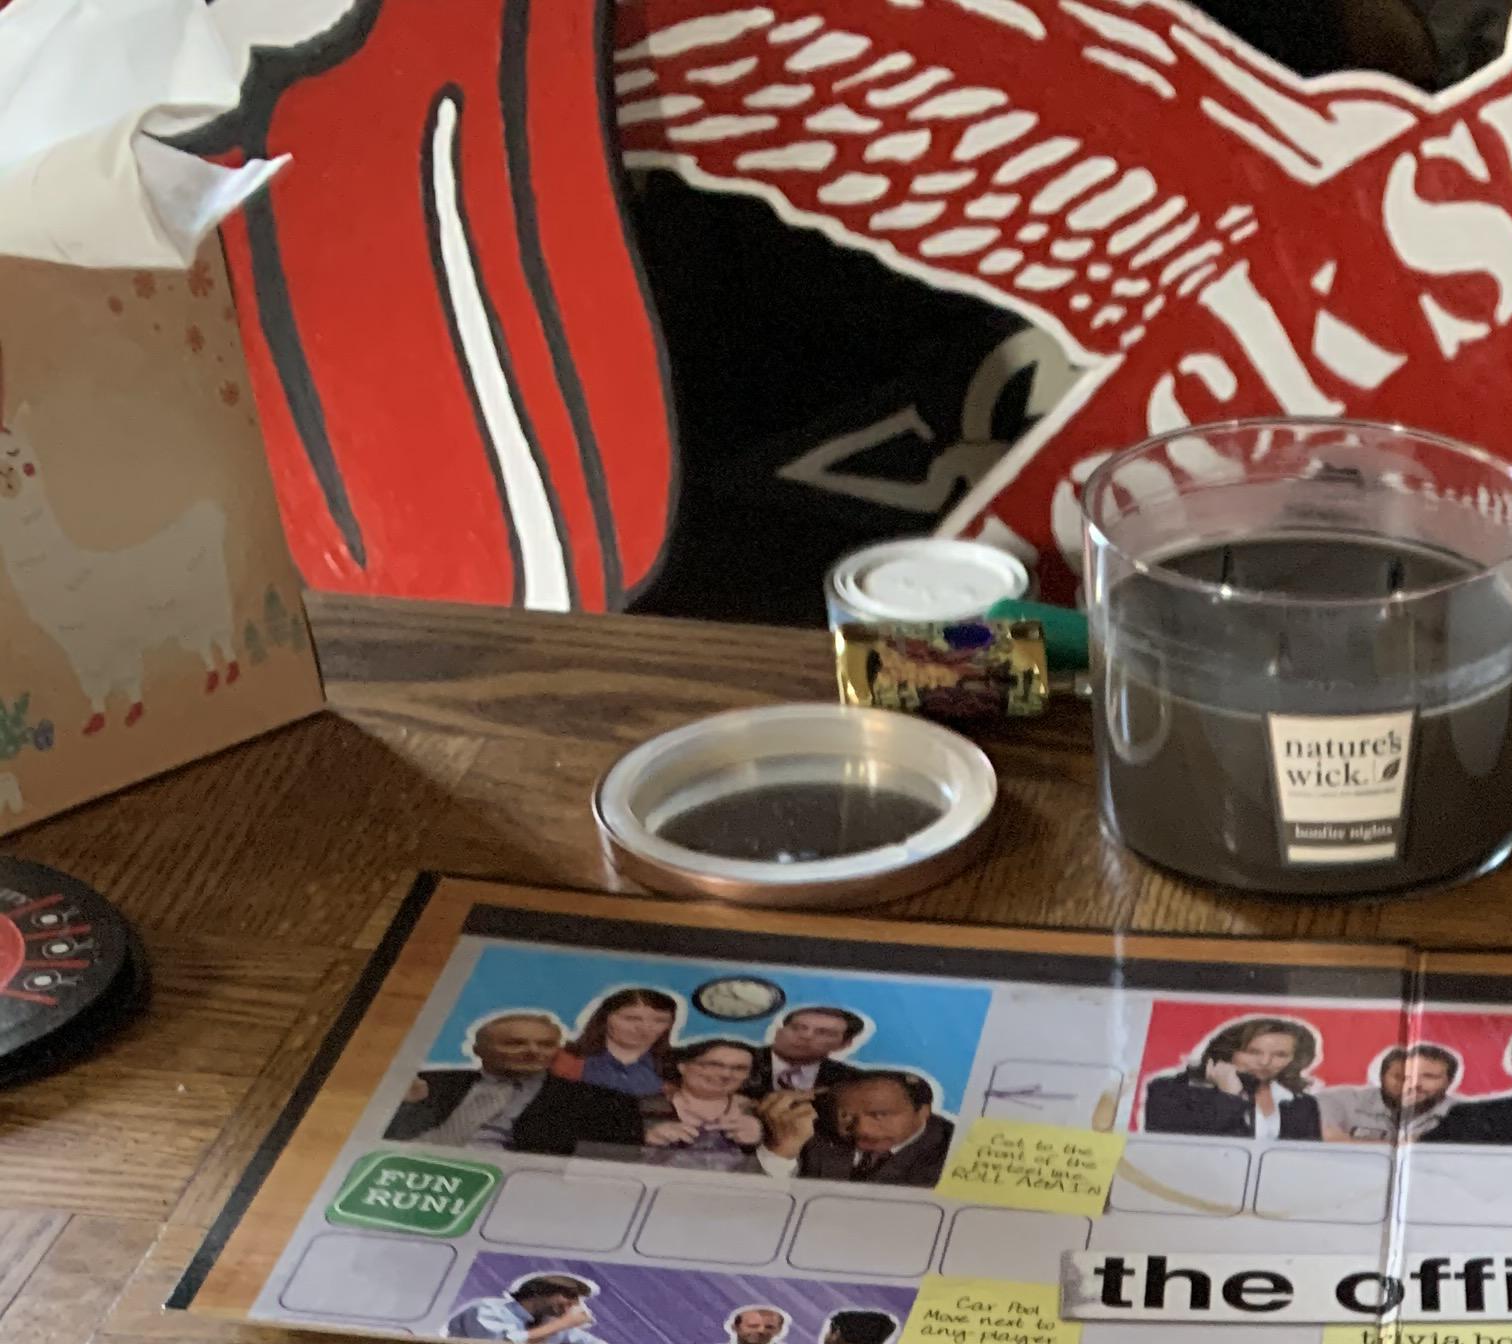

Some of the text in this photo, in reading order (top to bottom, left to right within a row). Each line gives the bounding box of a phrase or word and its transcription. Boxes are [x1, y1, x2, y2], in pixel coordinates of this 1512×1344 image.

[375, 1169, 464, 1194] FUN
[361, 1187, 465, 1215] RUN!
[1094, 1255, 1294, 1312] the
